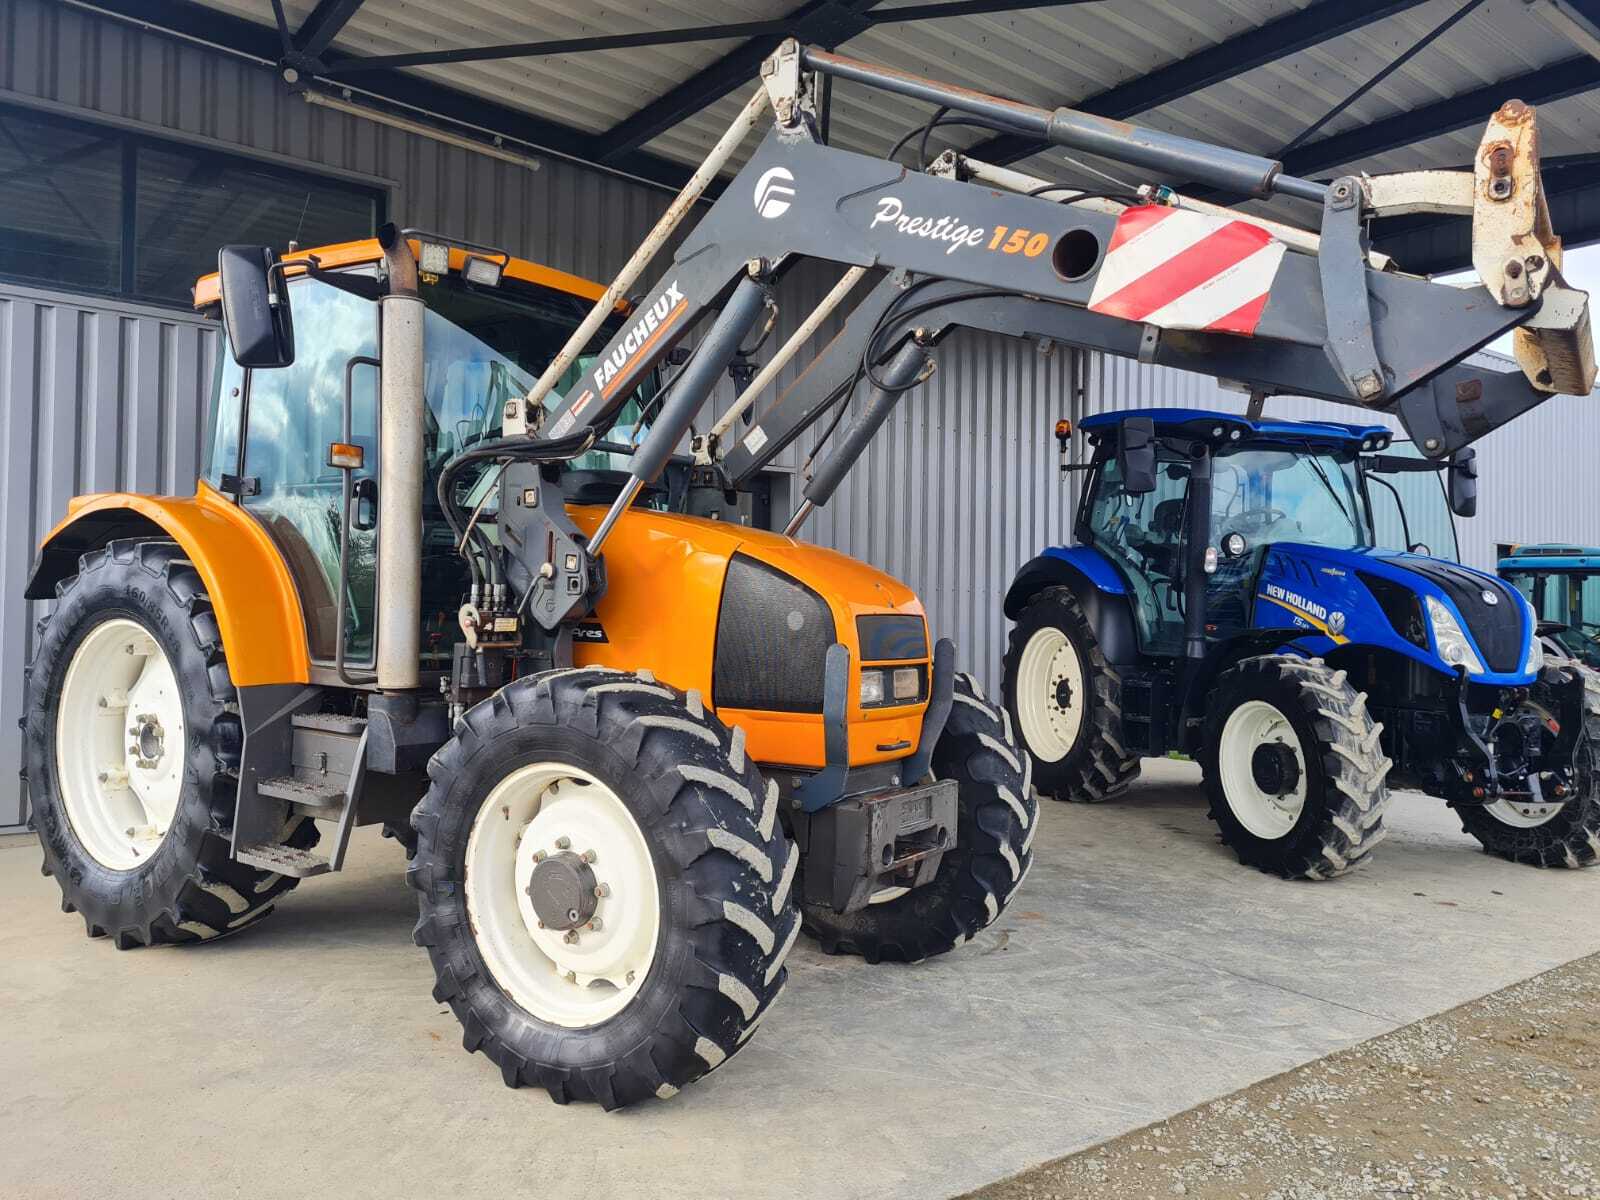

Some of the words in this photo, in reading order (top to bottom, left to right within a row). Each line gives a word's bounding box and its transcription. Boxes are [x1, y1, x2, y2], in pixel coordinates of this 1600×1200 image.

[870, 197, 985, 254] Prestige
[987, 225, 1050, 257] 150
[593, 280, 685, 391] FAUCHEUX
[1266, 583, 1286, 600] NEW
[1286, 591, 1326, 620] HOLLAND
